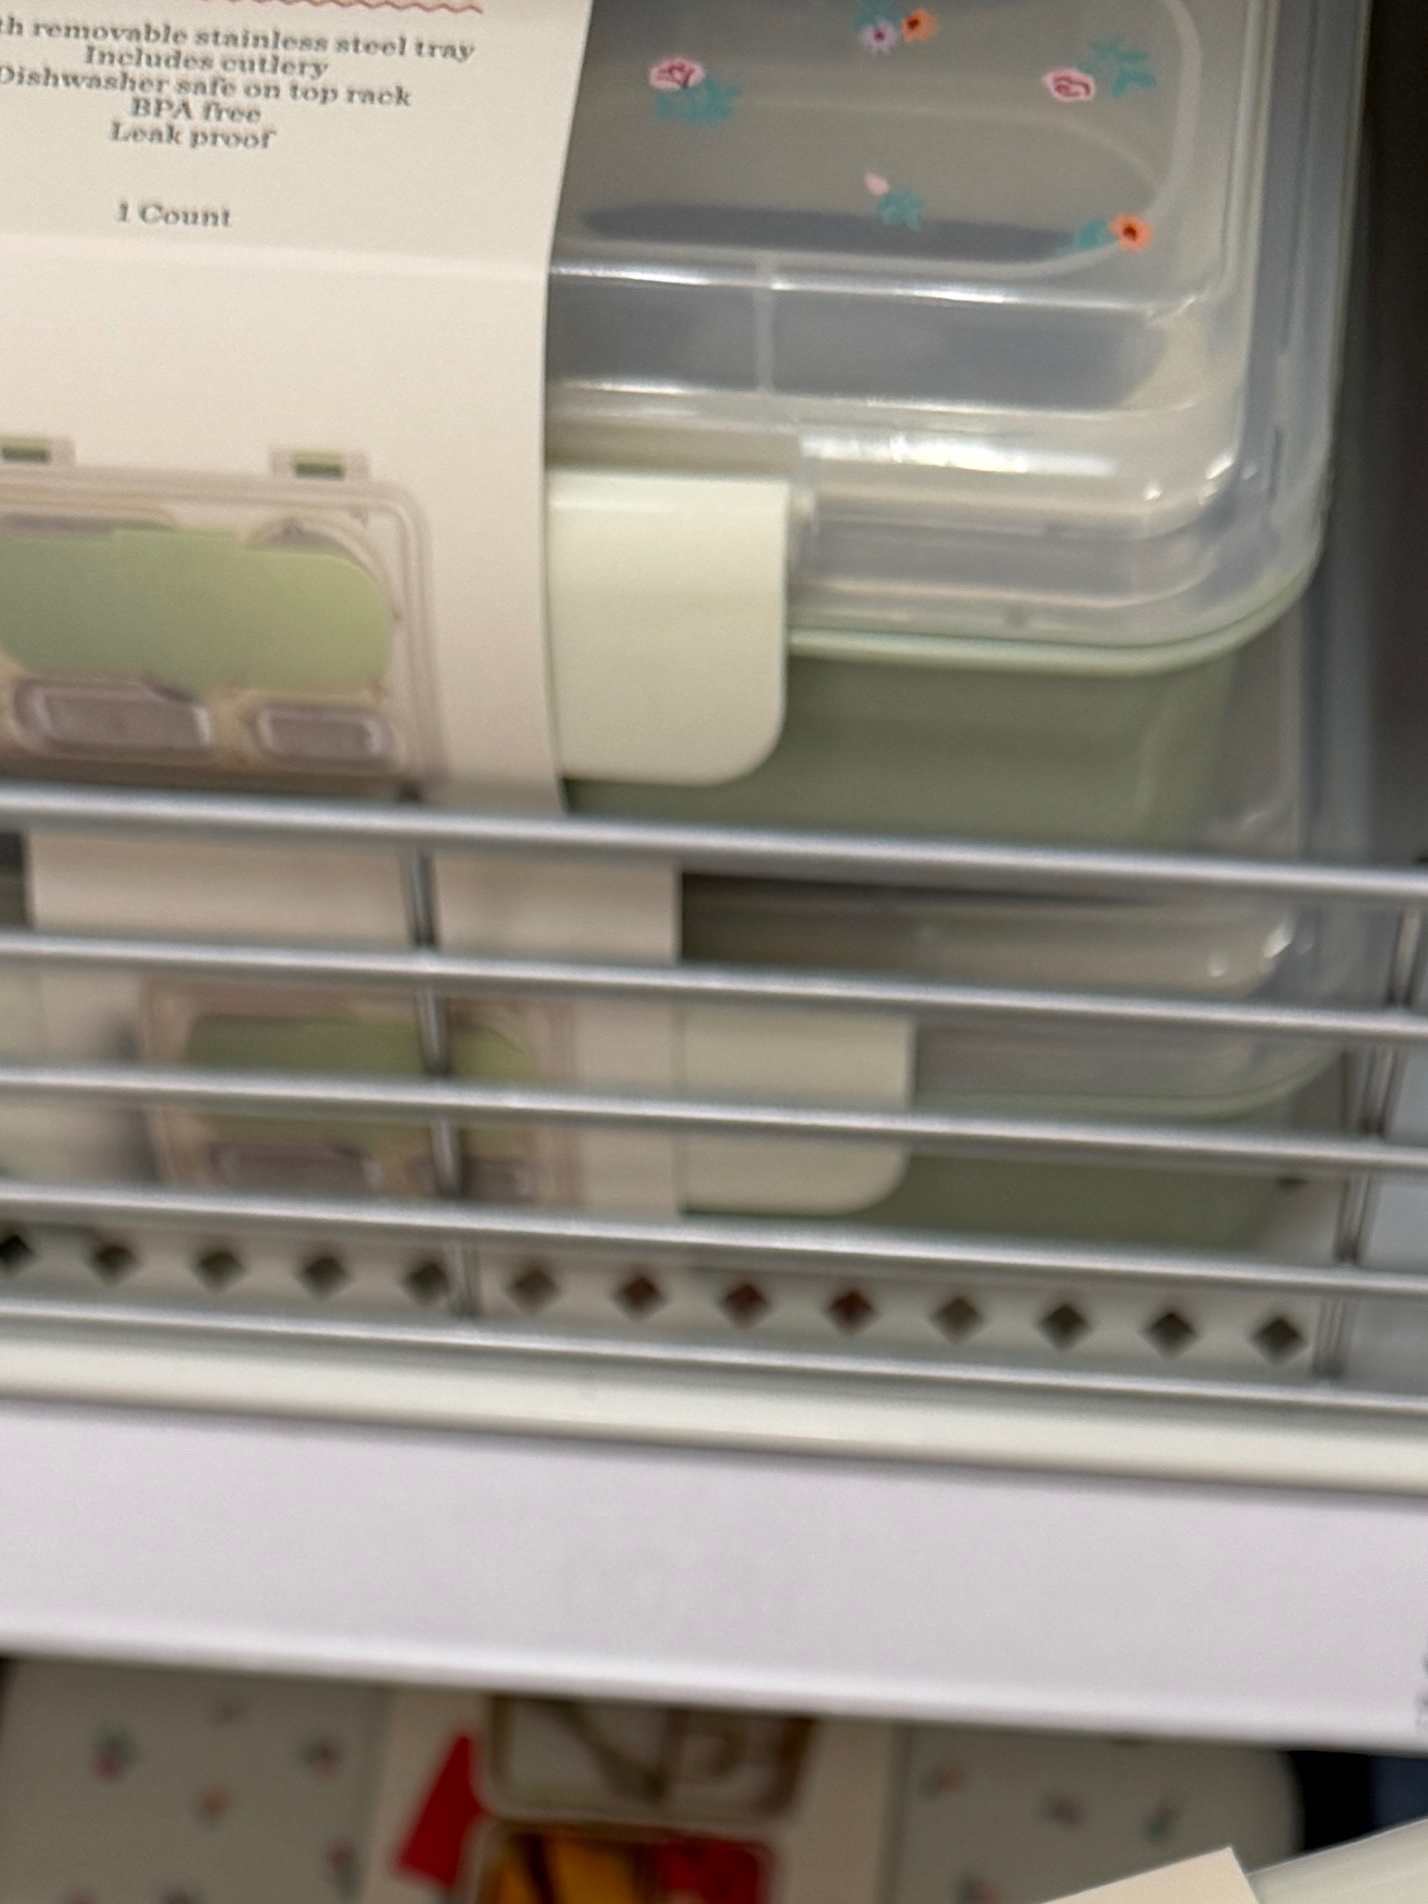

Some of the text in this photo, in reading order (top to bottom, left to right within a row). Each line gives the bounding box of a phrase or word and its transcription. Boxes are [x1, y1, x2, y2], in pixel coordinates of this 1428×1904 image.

[32, 19, 189, 47] removable
[195, 28, 329, 54] stainless
[335, 34, 408, 58] steel
[414, 40, 476, 63] tray
[84, 46, 329, 80] Includes cutlery
[175, 75, 237, 98] safe
[245, 83, 282, 100] on
[289, 82, 339, 105] top
[346, 86, 412, 108] rack
[129, 98, 262, 125] BPA free
[110, 121, 276, 151] Leak proof
[117, 201, 232, 229] 1 Count
